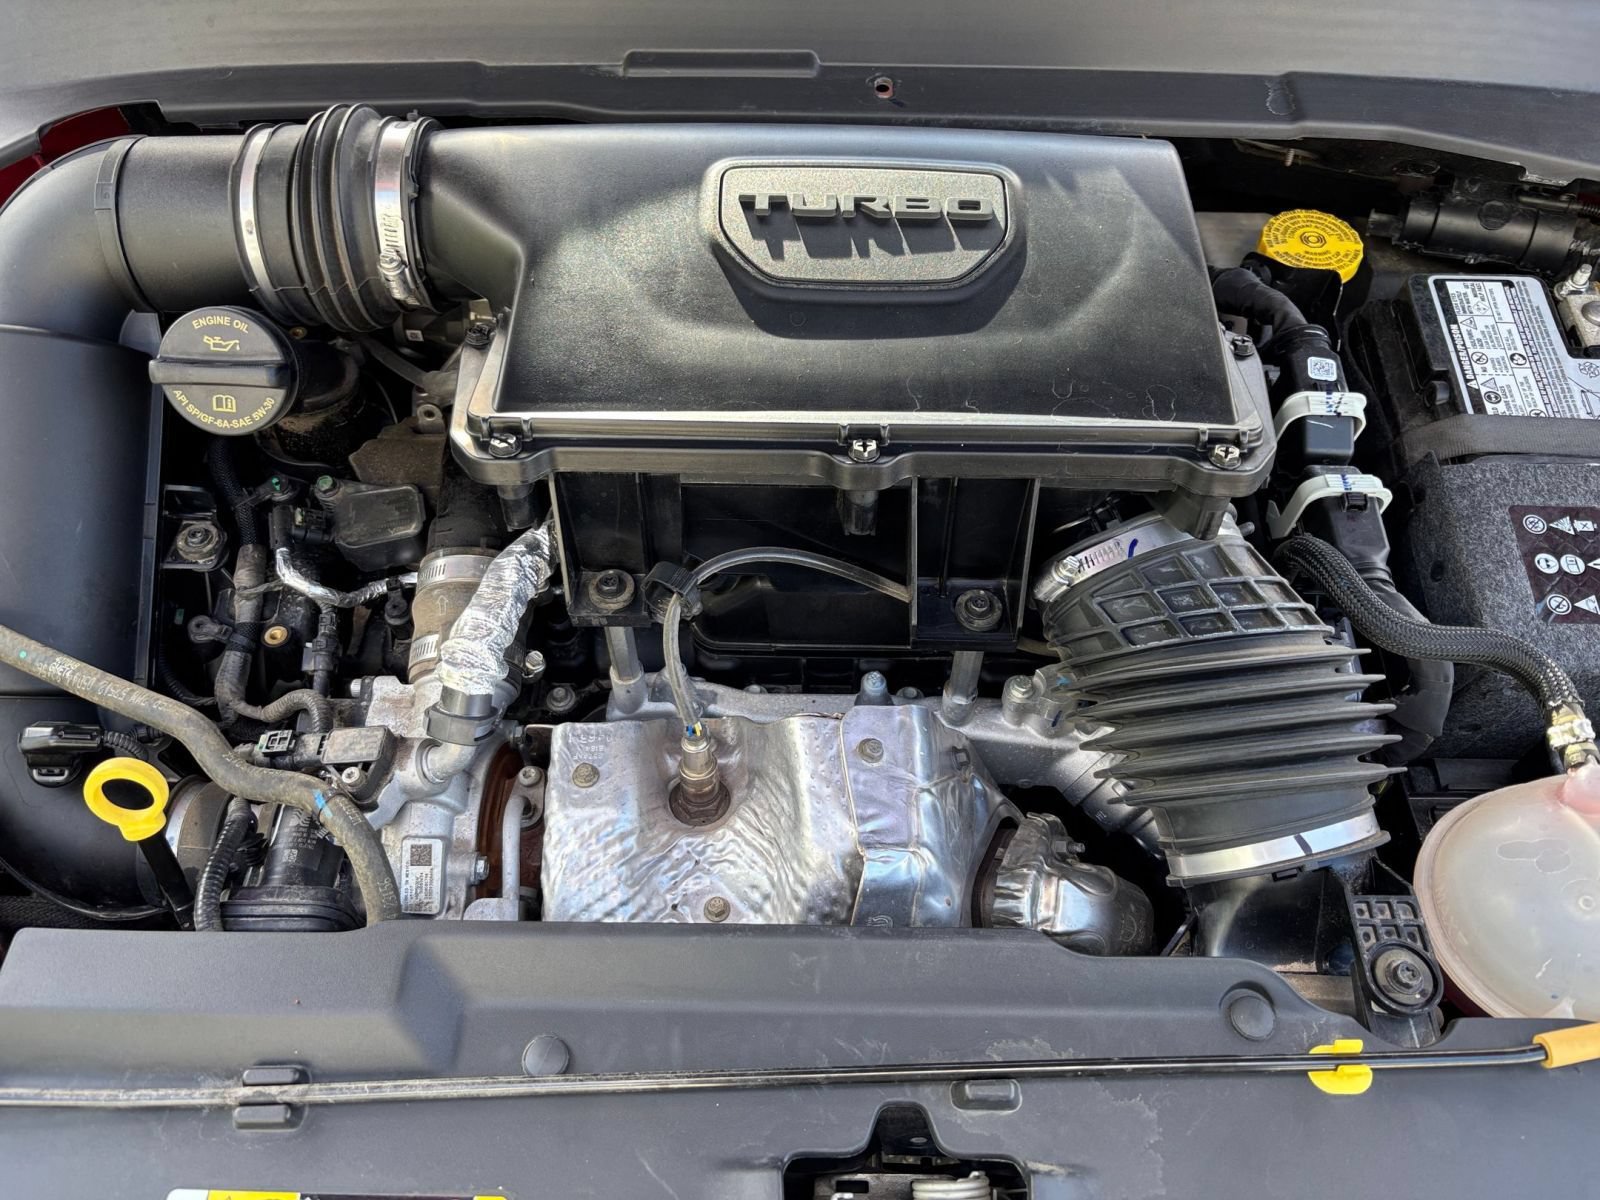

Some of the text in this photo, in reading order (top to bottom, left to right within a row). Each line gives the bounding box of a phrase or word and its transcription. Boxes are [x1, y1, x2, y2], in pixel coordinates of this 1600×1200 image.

[738, 193, 994, 221] TURBO
[192, 315, 249, 334] ENGINE OIL
[1450, 324, 1475, 380] DANGER/POISON
[173, 389, 189, 406] API
[251, 397, 275, 421] 5W-30
